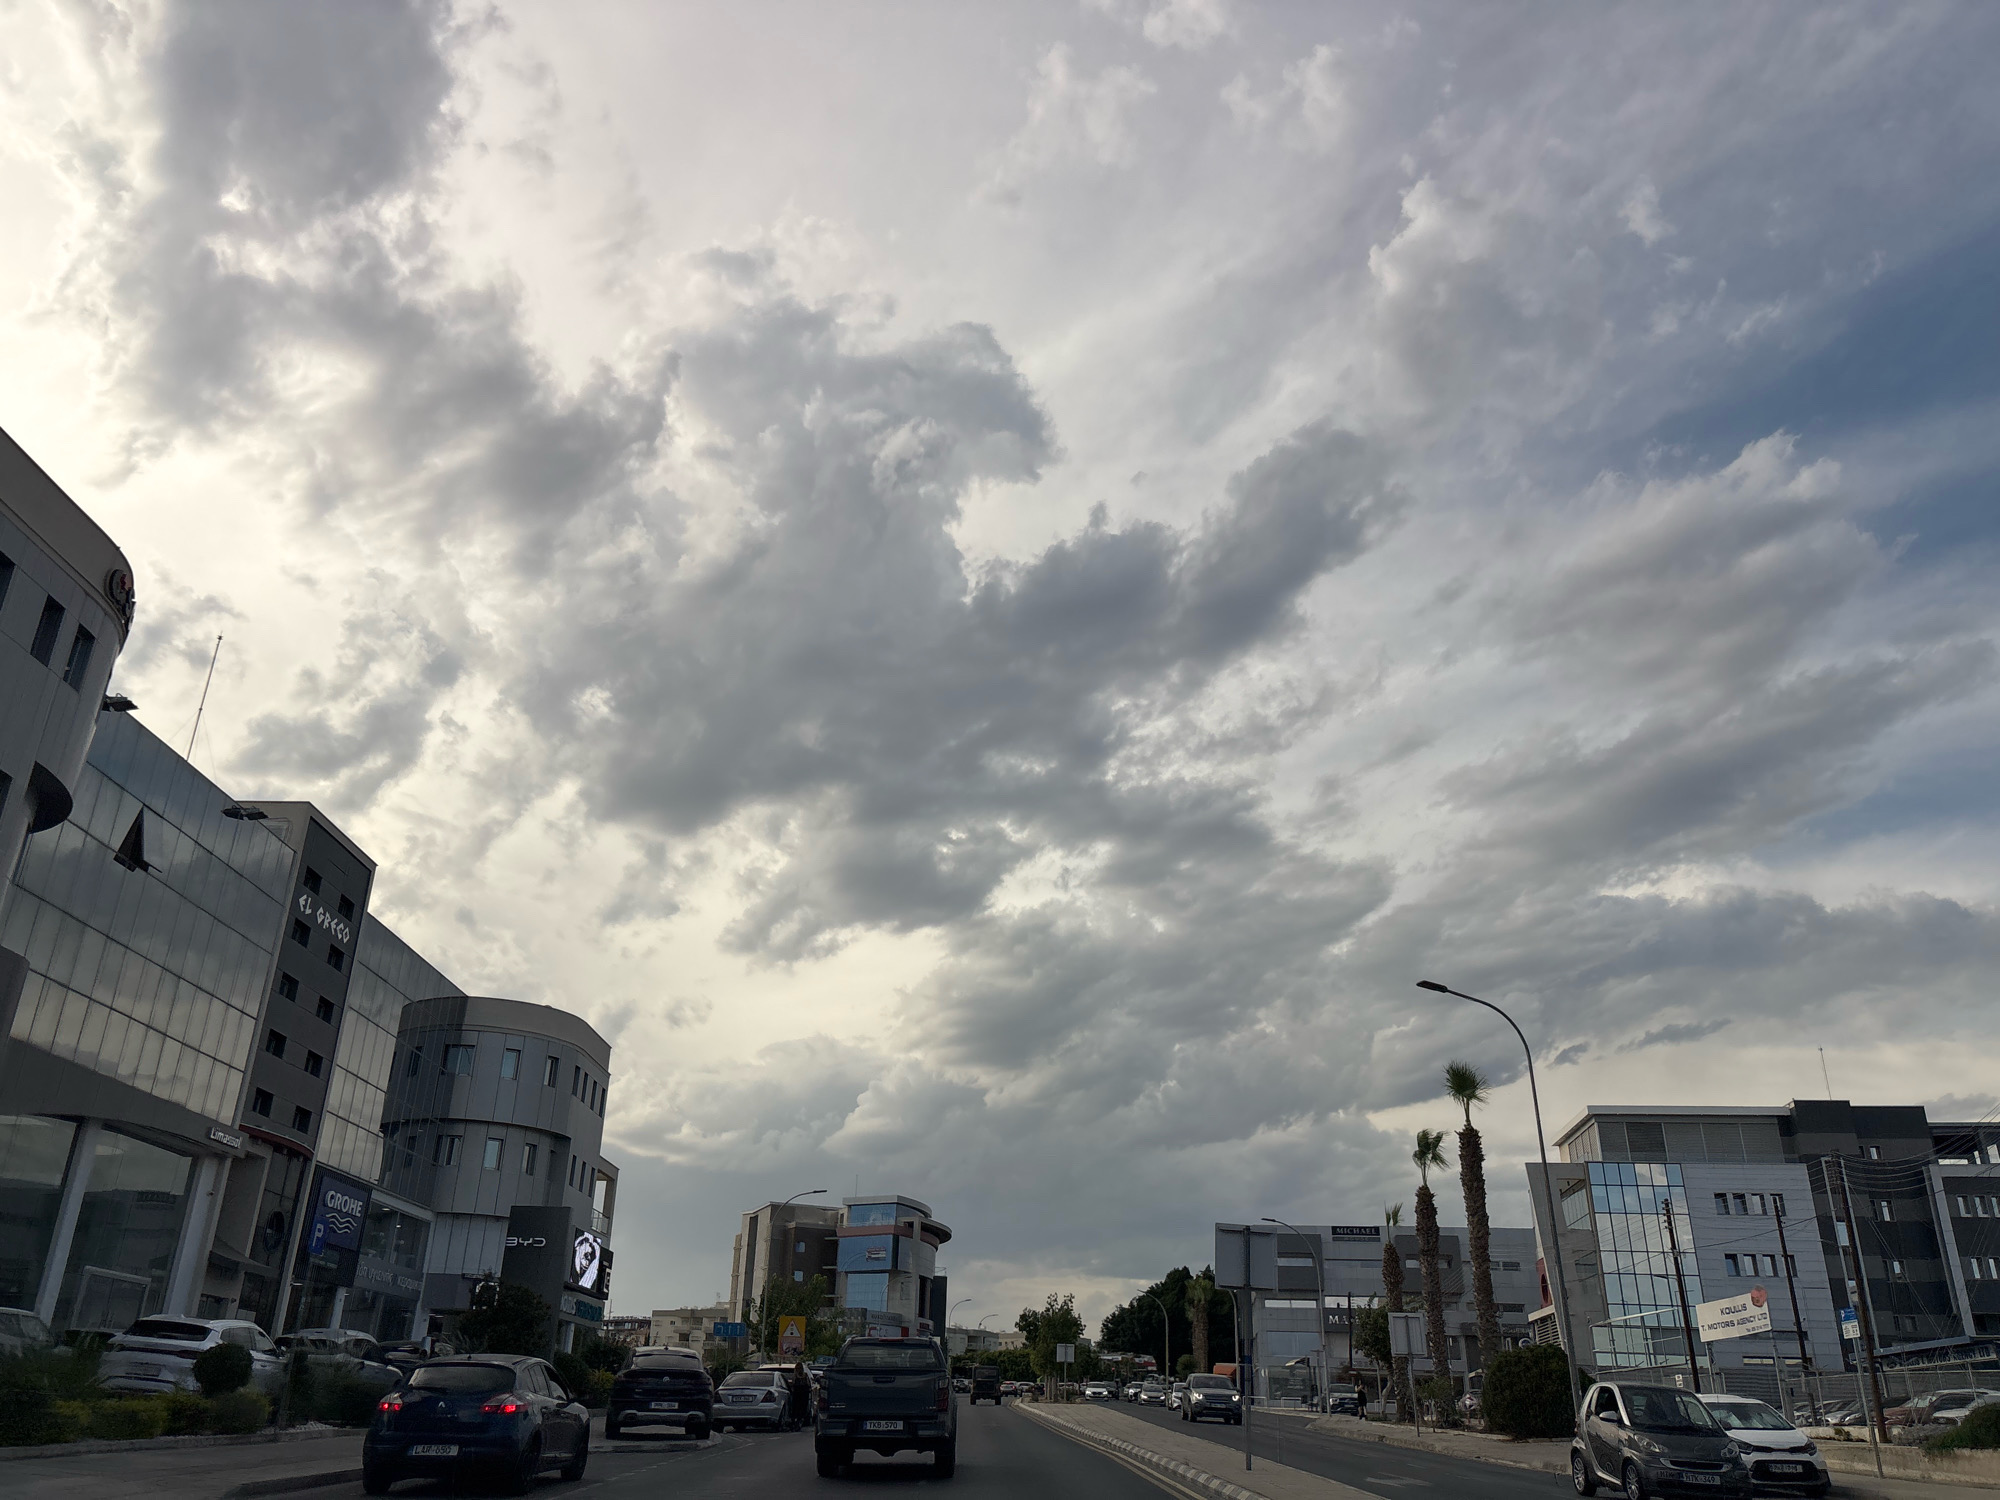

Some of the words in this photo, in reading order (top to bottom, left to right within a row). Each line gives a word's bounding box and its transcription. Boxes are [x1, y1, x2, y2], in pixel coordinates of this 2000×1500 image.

[316, 906, 350, 944] GRECO
[210, 1127, 243, 1149] Limassol
[325, 1190, 363, 1217] GROHE
[312, 1223, 324, 1247] P
[1335, 1227, 1377, 1235] MICHAEL
[505, 1236, 546, 1247] BYD
[1719, 1303, 1748, 1316] KOULLIS
[1707, 1319, 1736, 1331] MOTORS
[1736, 1315, 1757, 1326] AGENCY
[1757, 1312, 1768, 1321] LTD
[868, 1421, 882, 1430] TKB
[885, 1421, 898, 1430] 570
